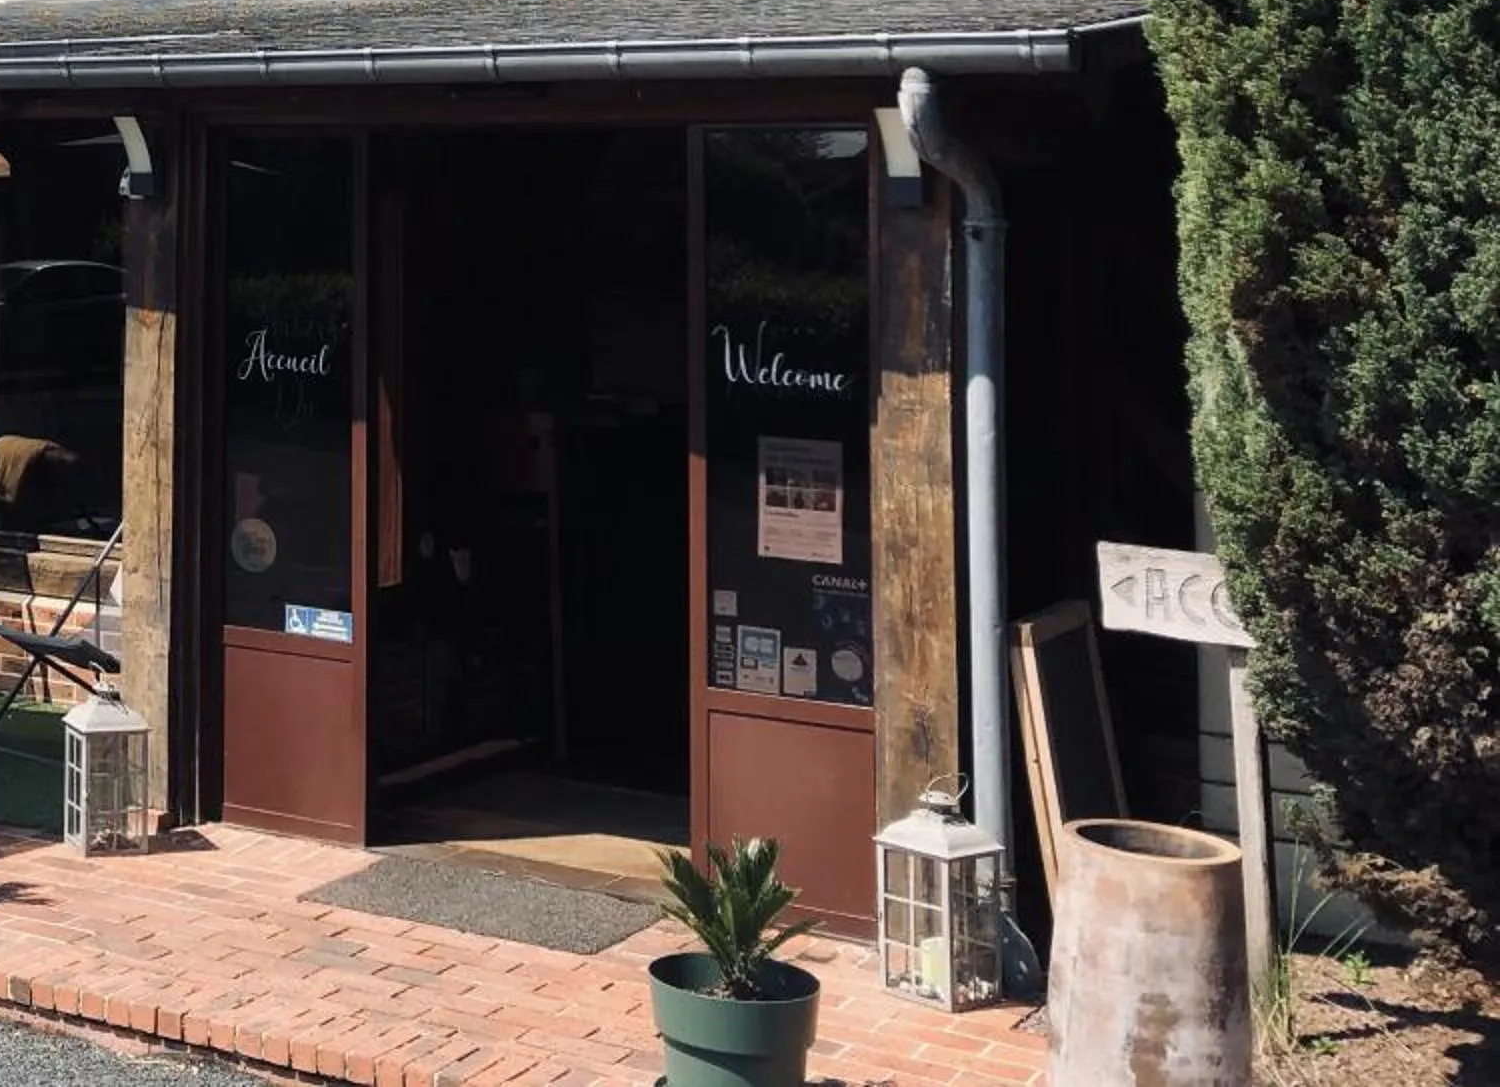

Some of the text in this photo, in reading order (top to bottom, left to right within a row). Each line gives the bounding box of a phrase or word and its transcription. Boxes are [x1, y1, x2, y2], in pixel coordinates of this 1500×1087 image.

[237, 326, 331, 382] Accueil
[710, 320, 853, 391] Welcome
[811, 573, 868, 592] CANAL+
